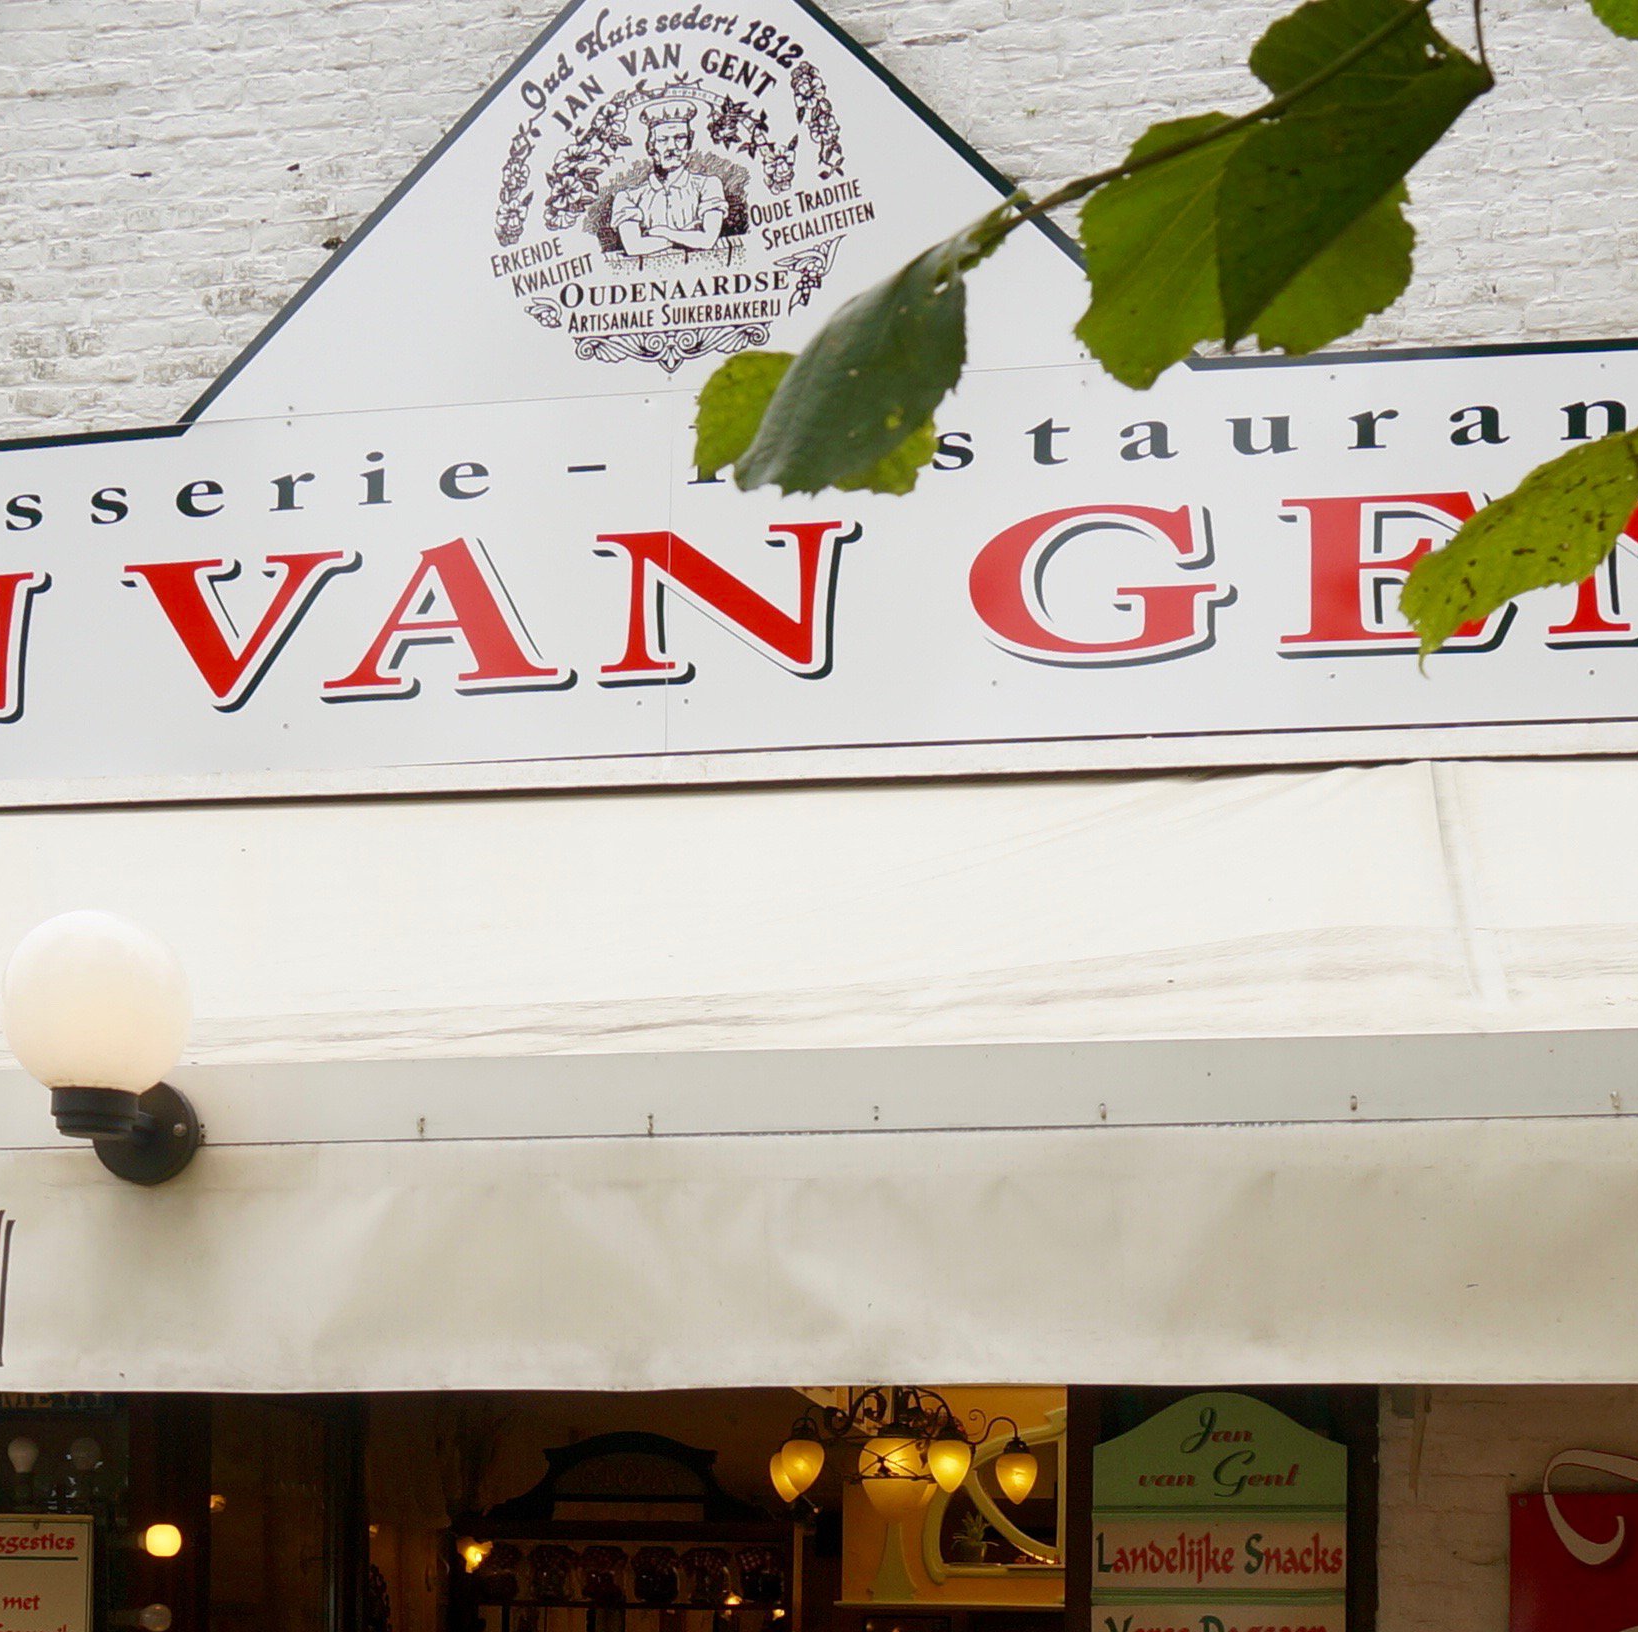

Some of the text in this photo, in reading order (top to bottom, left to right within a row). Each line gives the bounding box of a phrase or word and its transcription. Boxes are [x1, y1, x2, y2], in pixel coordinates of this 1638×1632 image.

[521, 52, 574, 110] Oud
[575, 7, 648, 61] Huis
[739, 19, 804, 69] 1812
[552, 43, 777, 132] JAN VAN GENT
[750, 178, 862, 227] OUDE TRADITIE
[762, 201, 875, 251] SPECIALITEITEN
[490, 236, 564, 278] ERKENDE
[513, 252, 594, 298] KWALITEIT
[560, 269, 790, 309] OUDENAARDSE
[568, 299, 781, 334] ARTISANALE SUIKERBAKKERIJ
[686, 399, 1626, 484] stauran
[123, 521, 860, 713] VAN
[1180, 1407, 1254, 1454] Jan
[1138, 1450, 1301, 1498] van Gent
[1095, 1532, 1343, 1584] Landelijke Snacks
[1, 1593, 40, 1611] met
